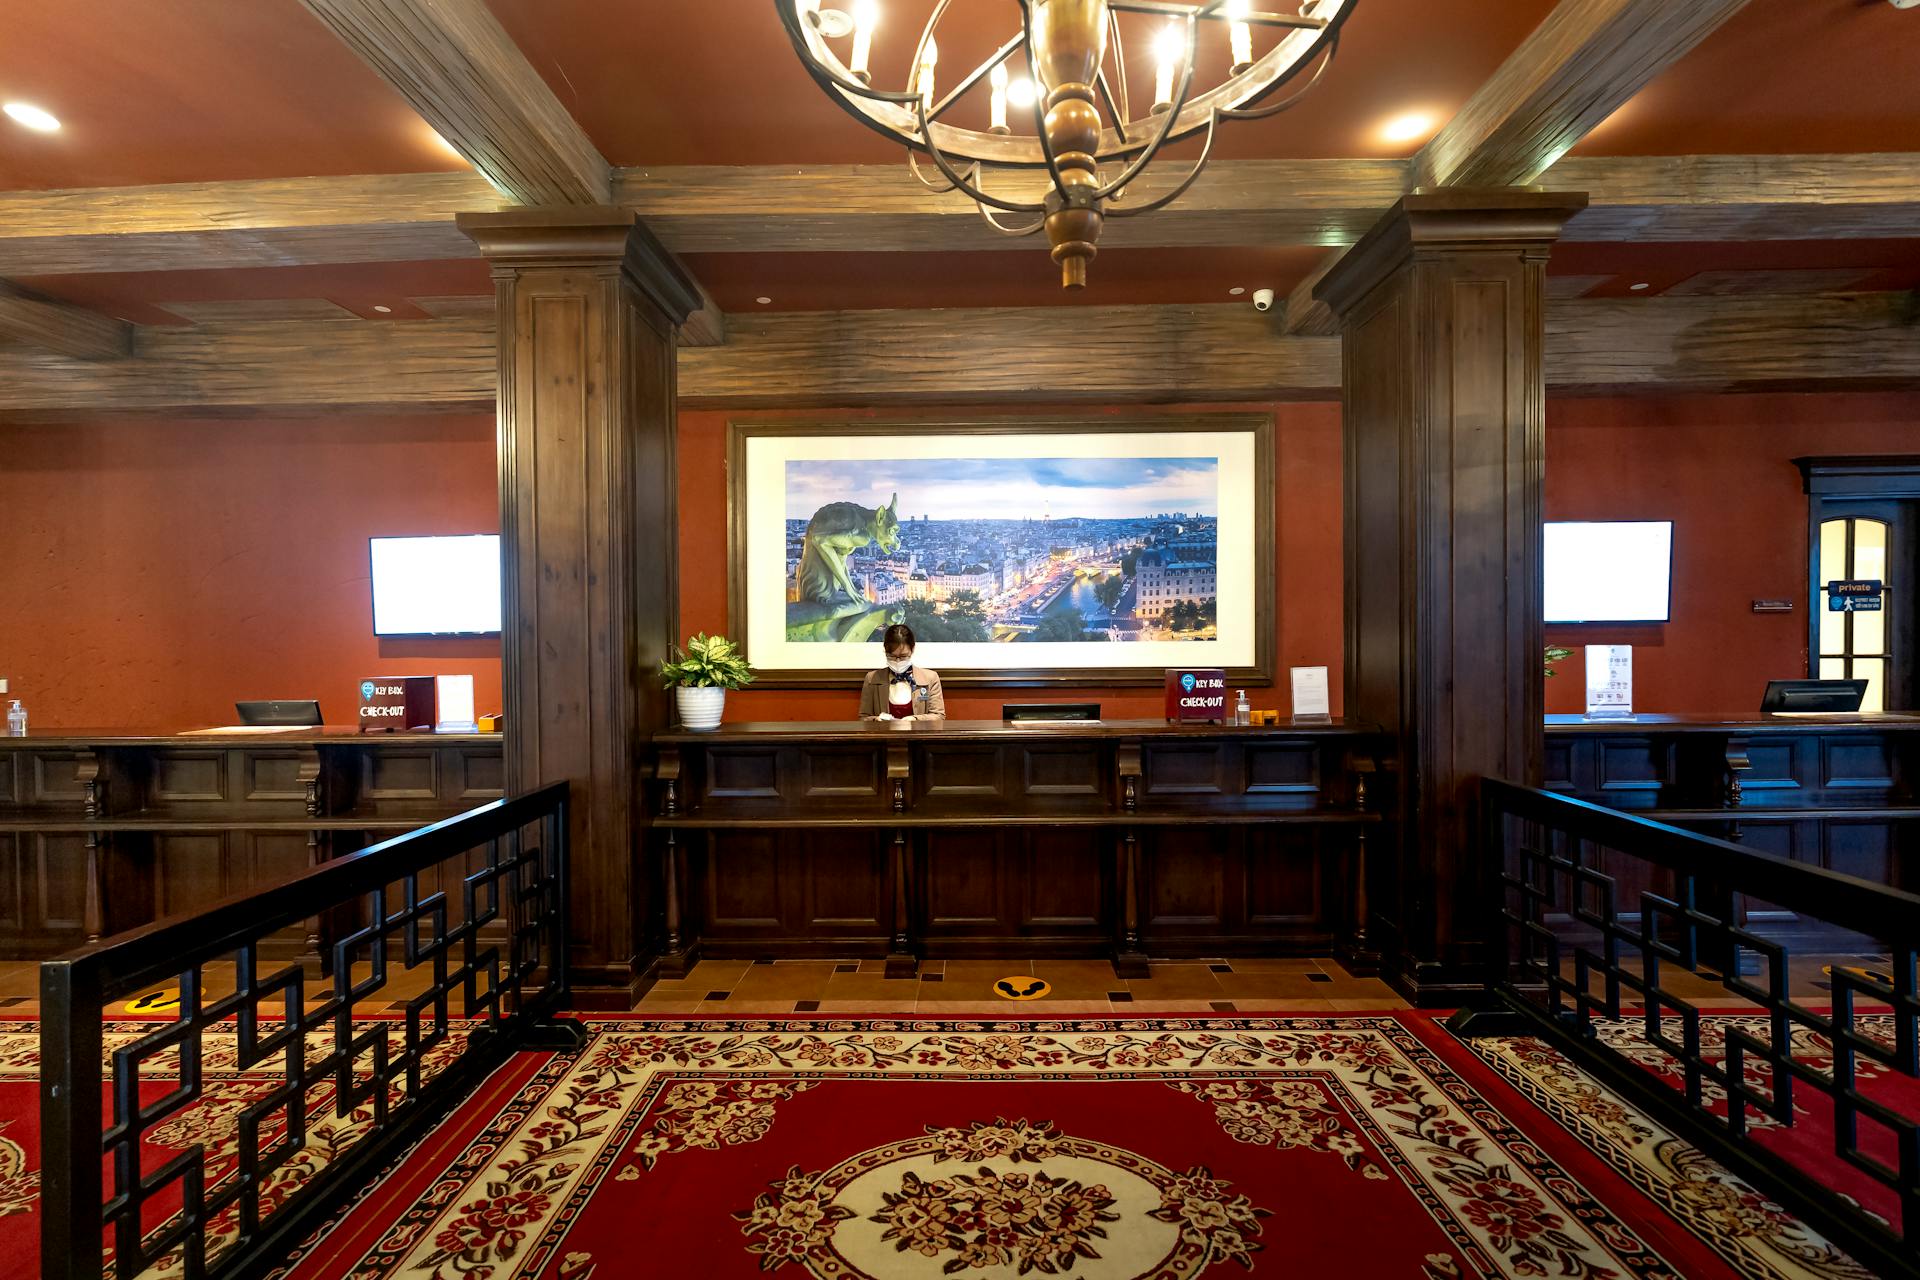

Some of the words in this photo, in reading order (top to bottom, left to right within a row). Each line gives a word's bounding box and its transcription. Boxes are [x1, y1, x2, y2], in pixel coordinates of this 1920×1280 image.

[1839, 584, 1871, 592] private
[1196, 680, 1208, 688] KEY
[1209, 679, 1223, 688] BOX
[375, 687, 387, 695] KEY
[388, 686, 403, 695] BOX
[1180, 697, 1223, 708] CHECK-OUT
[360, 706, 404, 717] CHECK-OUT
